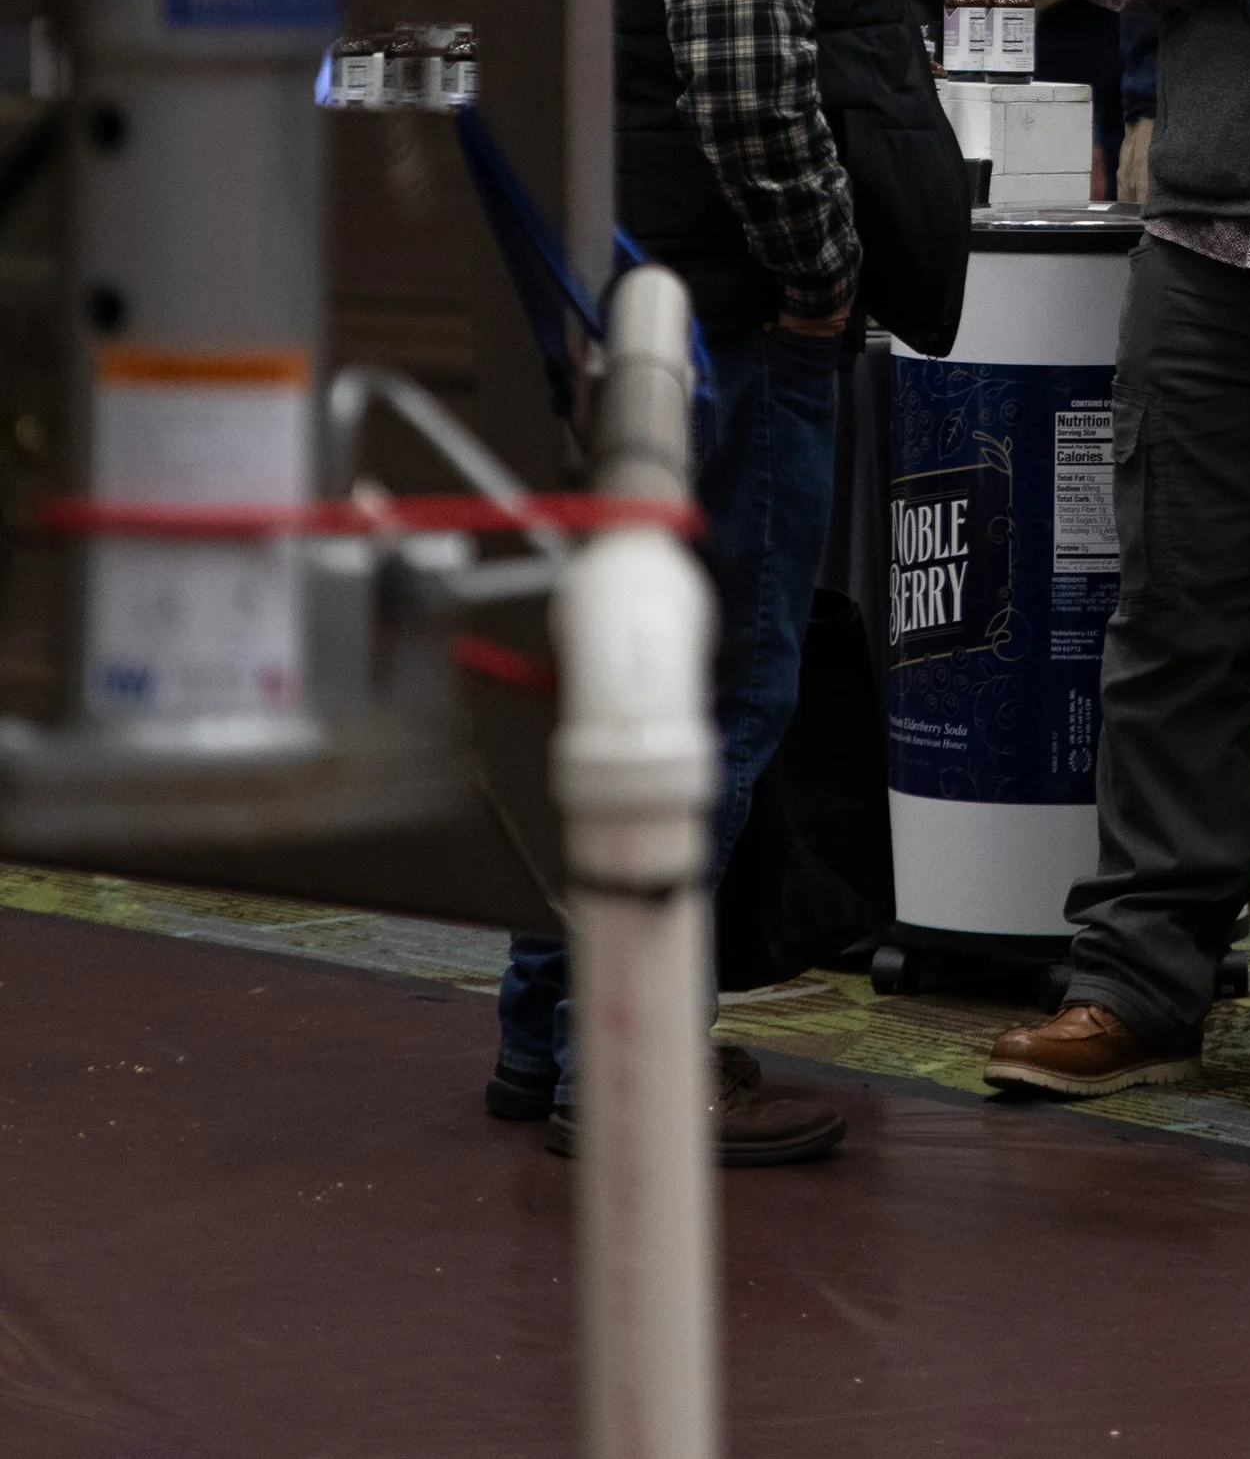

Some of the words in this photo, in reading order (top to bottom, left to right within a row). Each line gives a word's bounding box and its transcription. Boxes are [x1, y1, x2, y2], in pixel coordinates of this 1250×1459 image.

[1071, 400, 1103, 408] CONTAINS
[1057, 414, 1110, 427] Nutrition
[1057, 429, 1081, 437] Serving
[1057, 451, 1103, 462] Calories
[1057, 474, 1073, 482] Total
[1075, 474, 1085, 482] Fat
[1058, 506, 1080, 514] Dietary
[1059, 516, 1074, 524] Total
[1076, 516, 1098, 525] Sugars
[891, 499, 969, 566] NOBLE
[890, 561, 968, 646] BERRY
[904, 717, 942, 736] Elderberry
[943, 723, 968, 736] Soda
[942, 739, 968, 753] Honey
